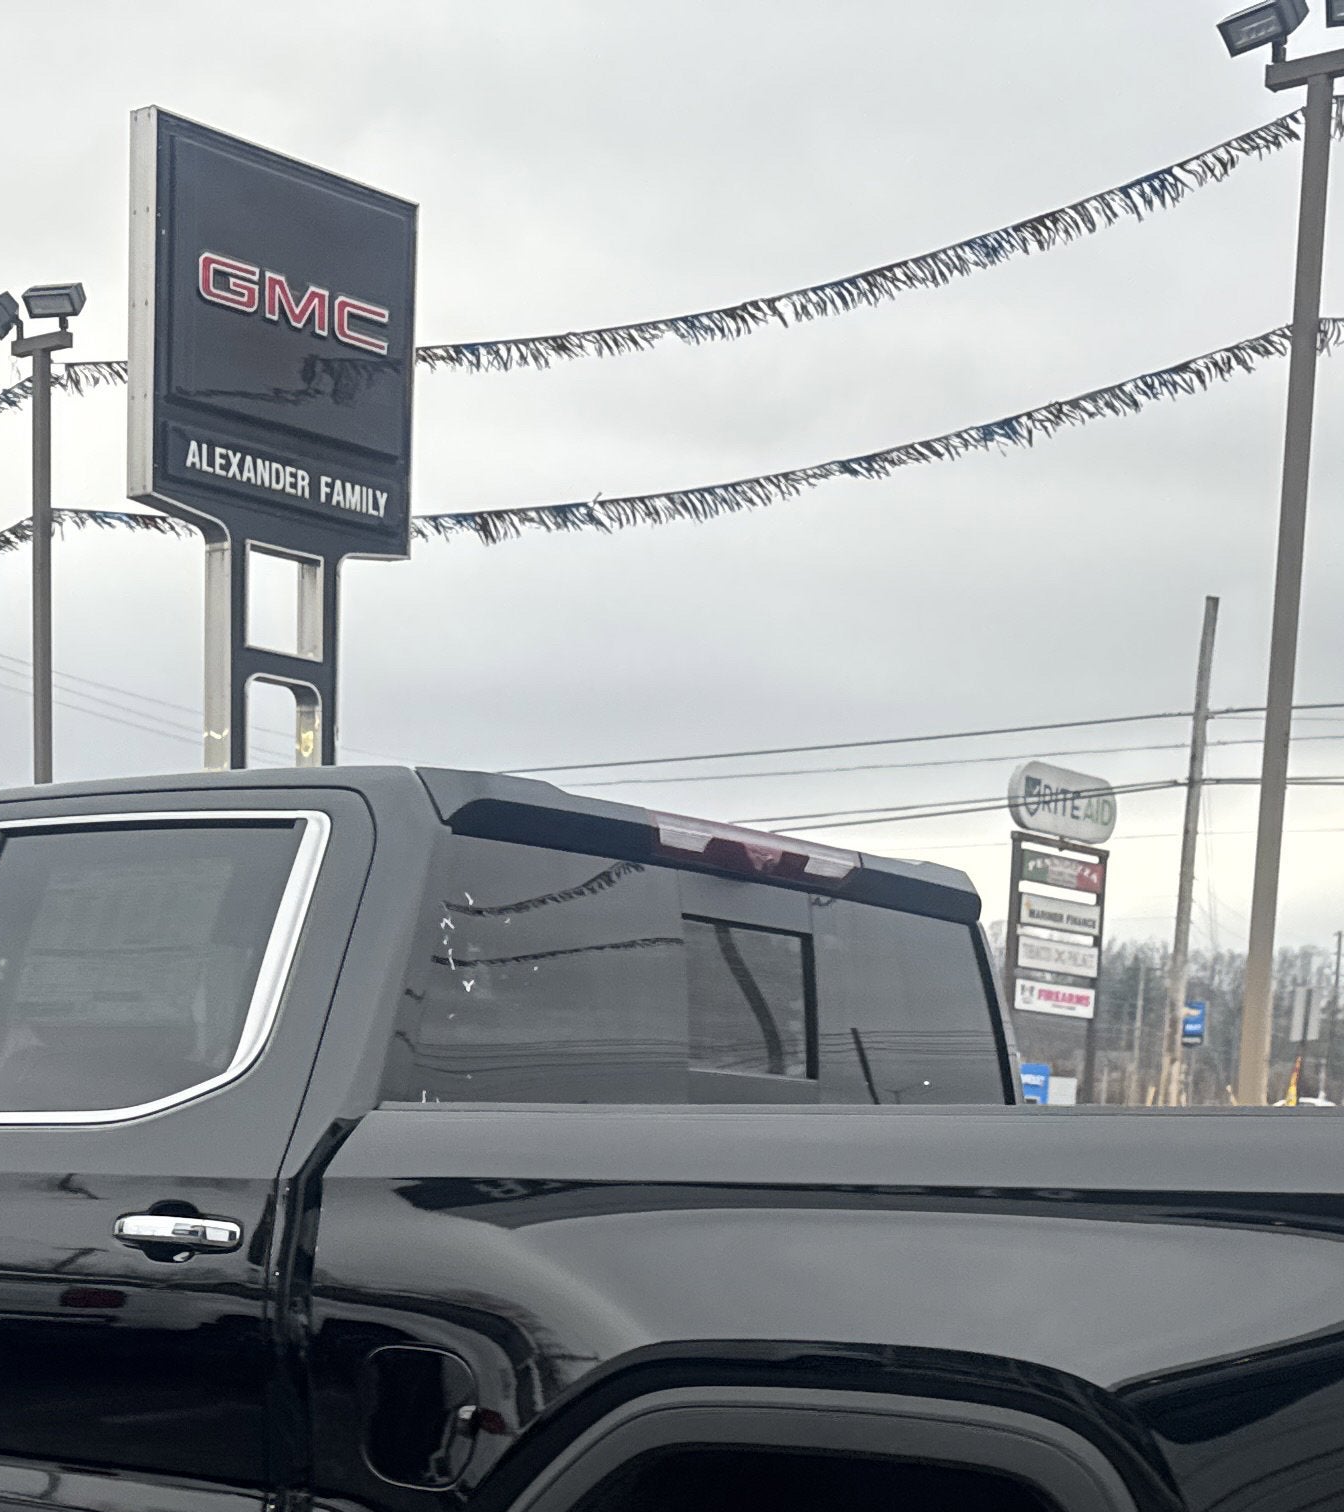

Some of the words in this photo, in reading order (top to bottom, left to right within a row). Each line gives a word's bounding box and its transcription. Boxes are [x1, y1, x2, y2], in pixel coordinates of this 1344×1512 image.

[198, 252, 389, 355] GMC
[186, 440, 310, 500] ALEXANDER
[320, 475, 388, 519] FAMILY
